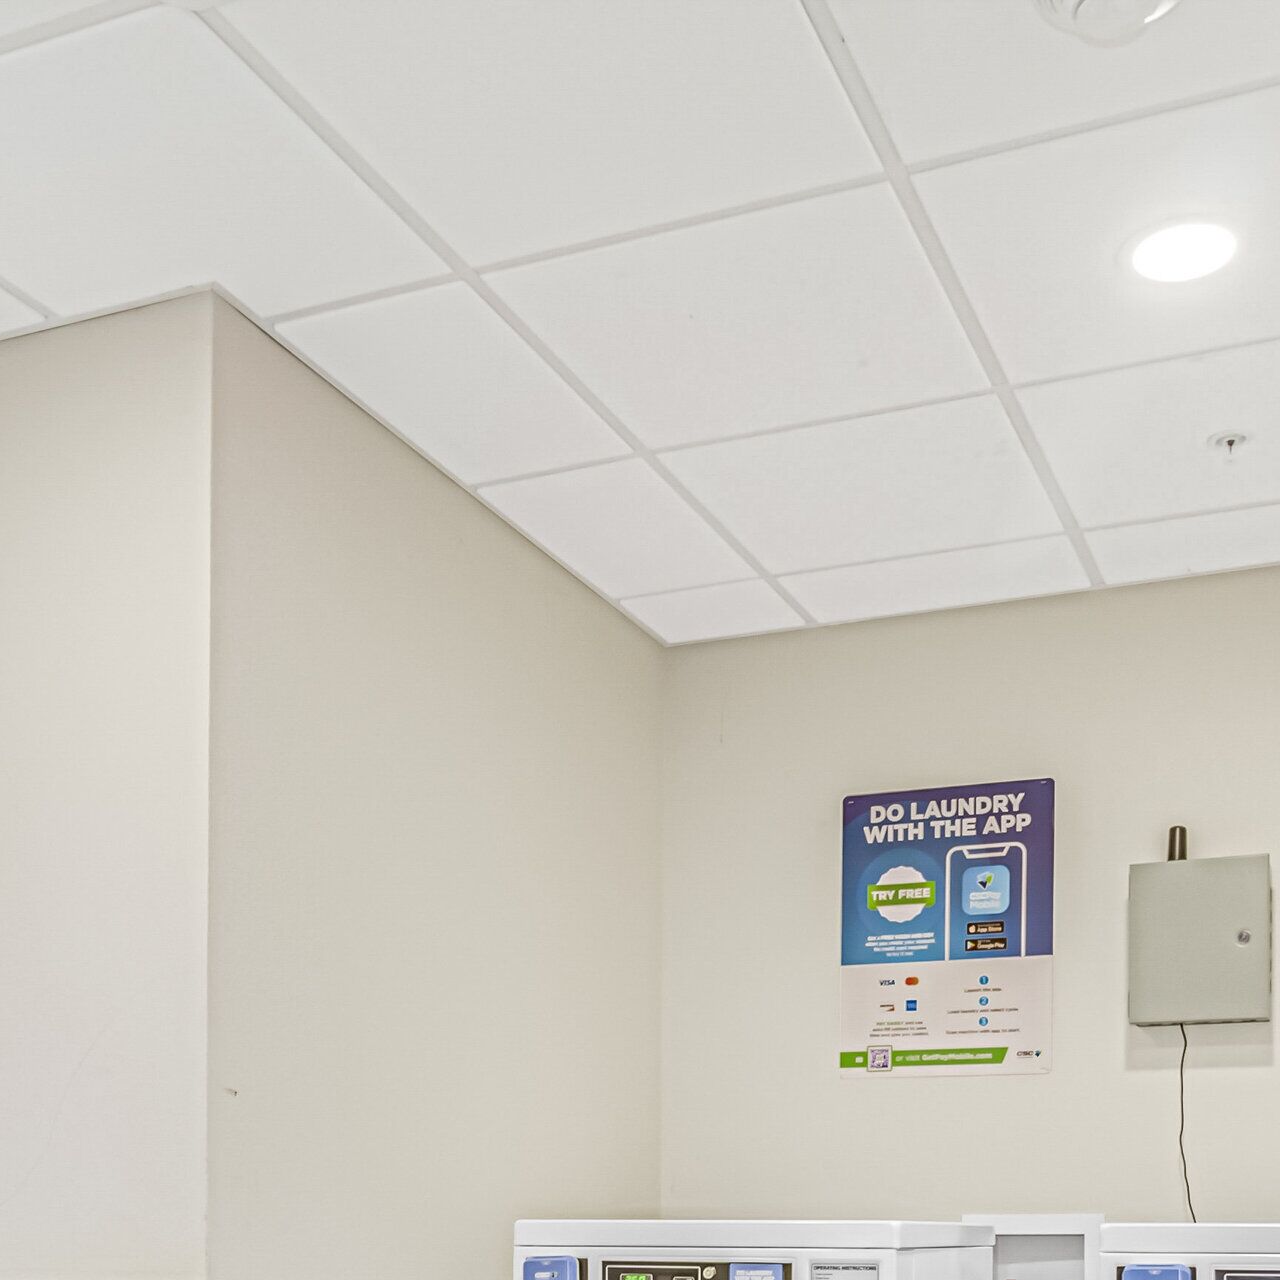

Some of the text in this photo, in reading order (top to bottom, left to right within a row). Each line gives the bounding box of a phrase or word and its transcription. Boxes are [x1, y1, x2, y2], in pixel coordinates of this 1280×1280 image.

[870, 792, 1025, 824] DO LAUNDRY
[863, 813, 1032, 844] WITH THE APP
[871, 887, 931, 901] TRY FREE
